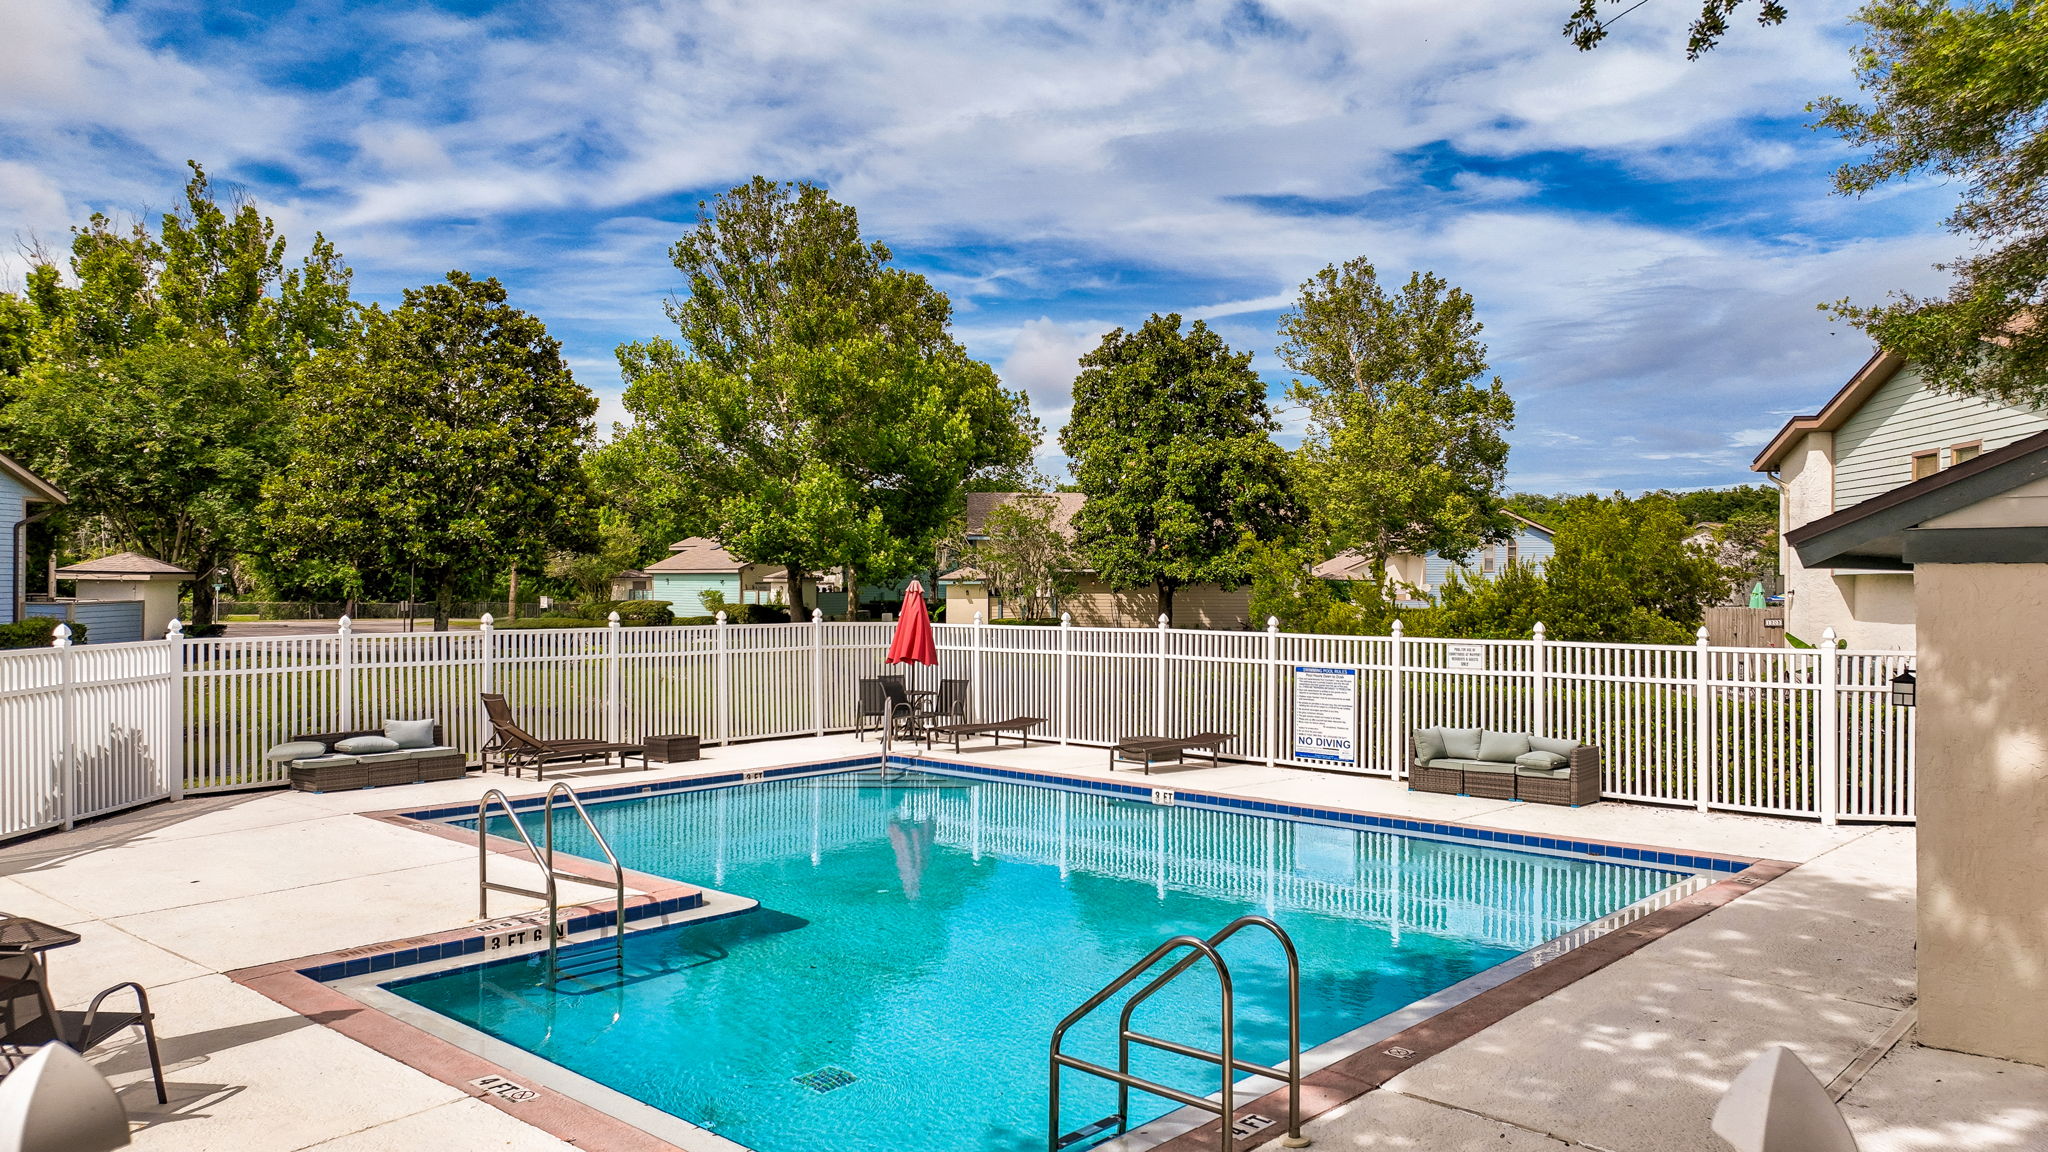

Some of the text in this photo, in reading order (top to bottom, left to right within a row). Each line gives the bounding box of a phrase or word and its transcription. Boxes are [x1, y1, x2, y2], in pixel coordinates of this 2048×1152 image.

[1298, 736, 1351, 749] NO DIVING
[491, 936, 501, 950] 3
[508, 931, 526, 947] FT
[479, 1078, 520, 1095] 4 FT
[1239, 1114, 1273, 1129] FT
